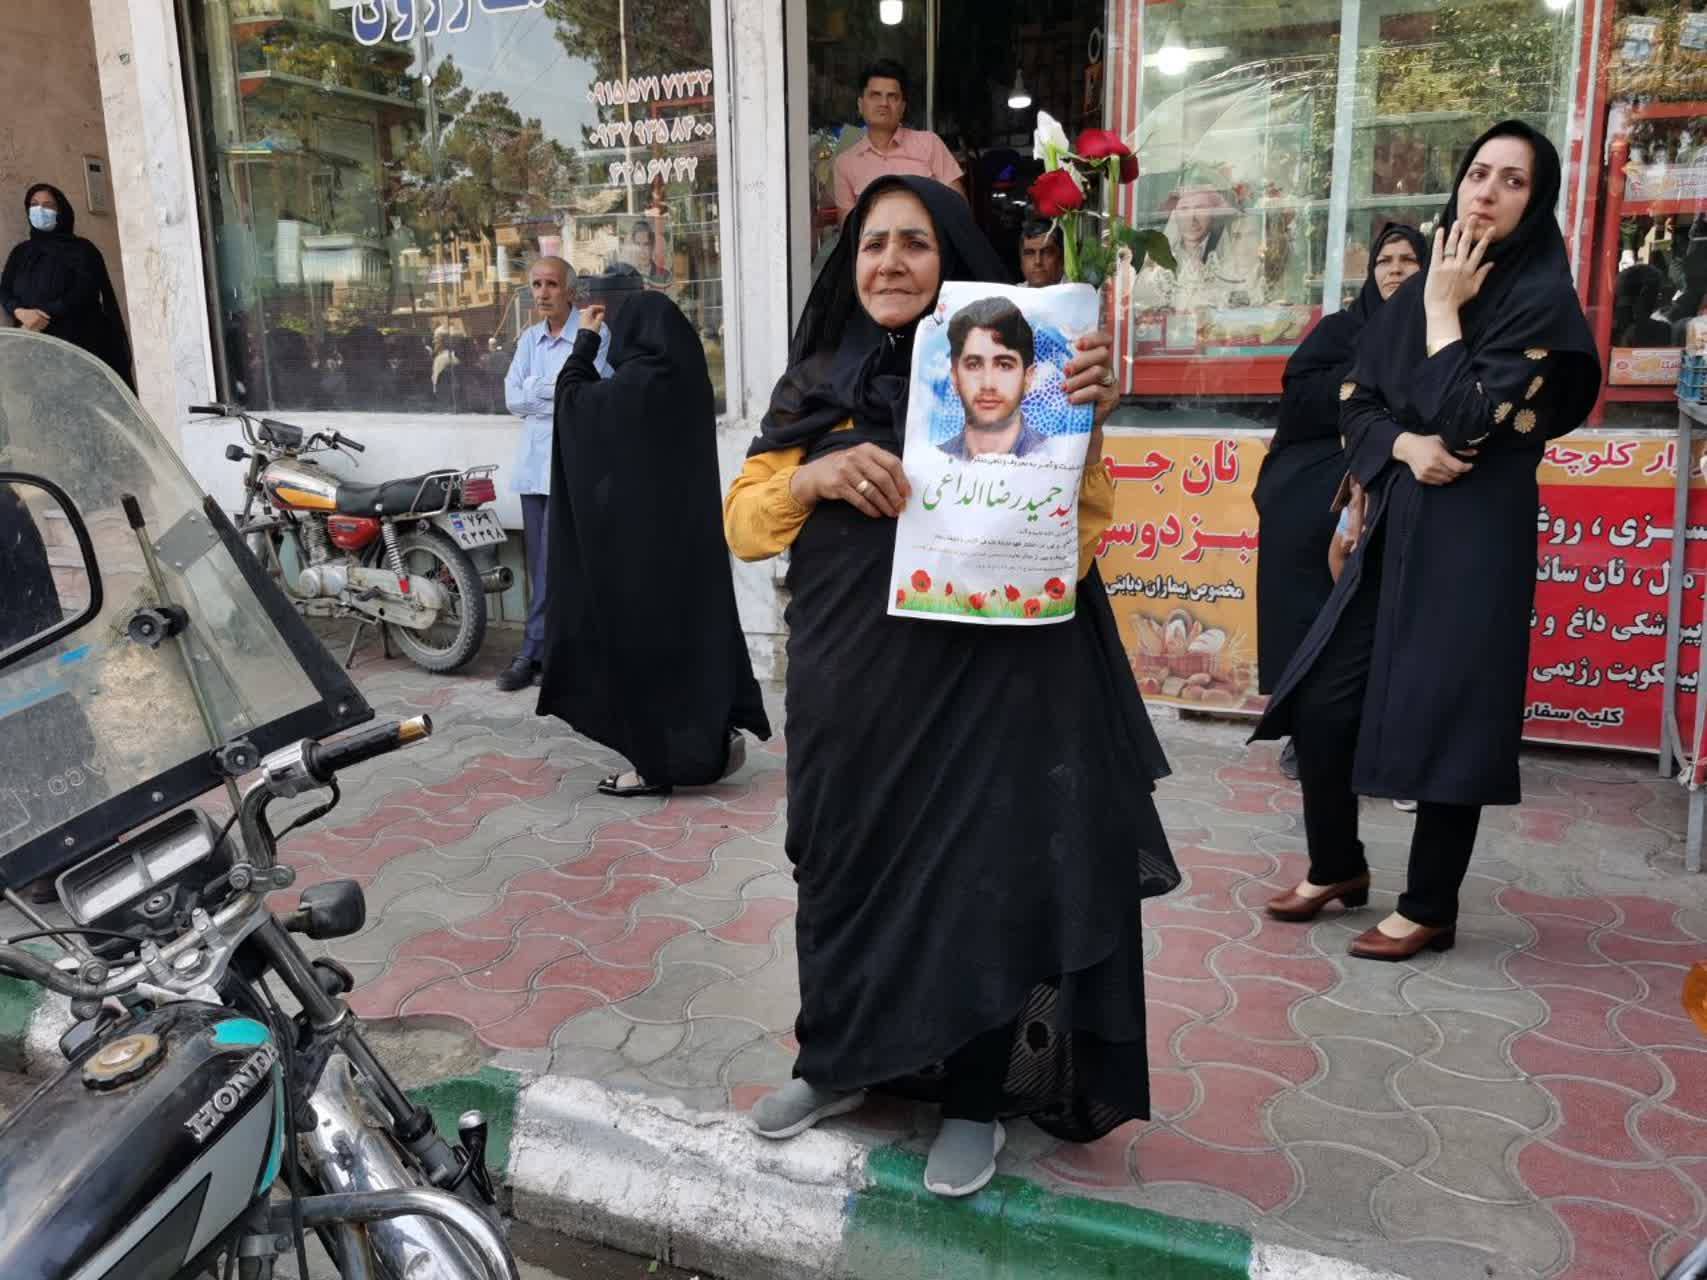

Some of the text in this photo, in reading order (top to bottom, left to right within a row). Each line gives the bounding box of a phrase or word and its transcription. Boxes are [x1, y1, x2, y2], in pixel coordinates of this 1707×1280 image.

[1182, 440, 1239, 495] نان
[1544, 442, 1638, 474] کلوچه
[1104, 572, 1244, 602] مخصوص بیماران دیابتی
[1584, 558, 1625, 592] نان
[1566, 606, 1607, 637] داغ
[1533, 657, 1602, 688] رژیمی
[1524, 703, 1623, 728] کلیه سفار
[184, 1042, 279, 1142] HONDA
